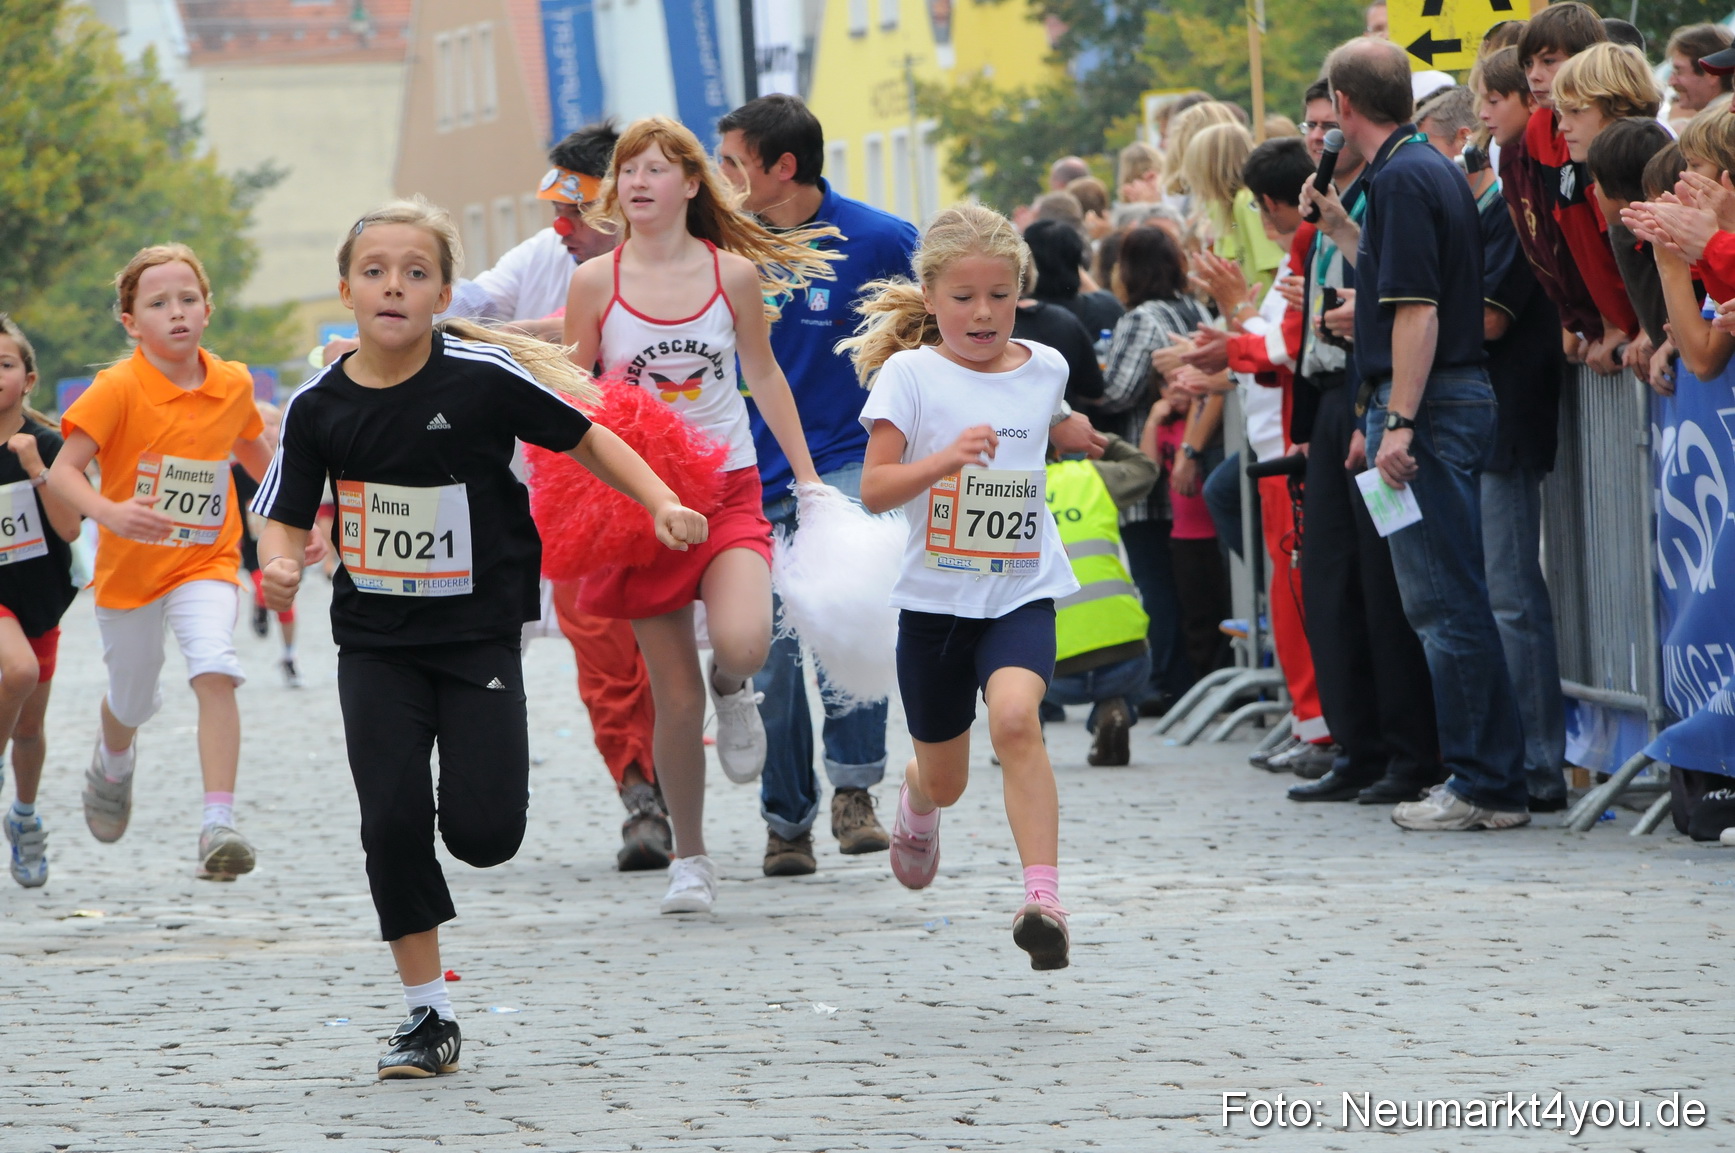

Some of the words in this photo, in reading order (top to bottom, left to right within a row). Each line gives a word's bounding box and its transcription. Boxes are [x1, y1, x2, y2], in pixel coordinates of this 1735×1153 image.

[165, 464, 215, 484] Annette
[137, 481, 151, 495] K3
[966, 475, 1037, 498] Franziska
[164, 489, 222, 516] 7078
[371, 493, 410, 517] Anna
[933, 503, 950, 519] K3
[344, 521, 359, 538] K3
[966, 509, 1037, 540] 7025
[373, 528, 454, 560] 7021
[1004, 559, 1040, 569] PFLEIDERER
[417, 578, 470, 589] PFLEIDERER
